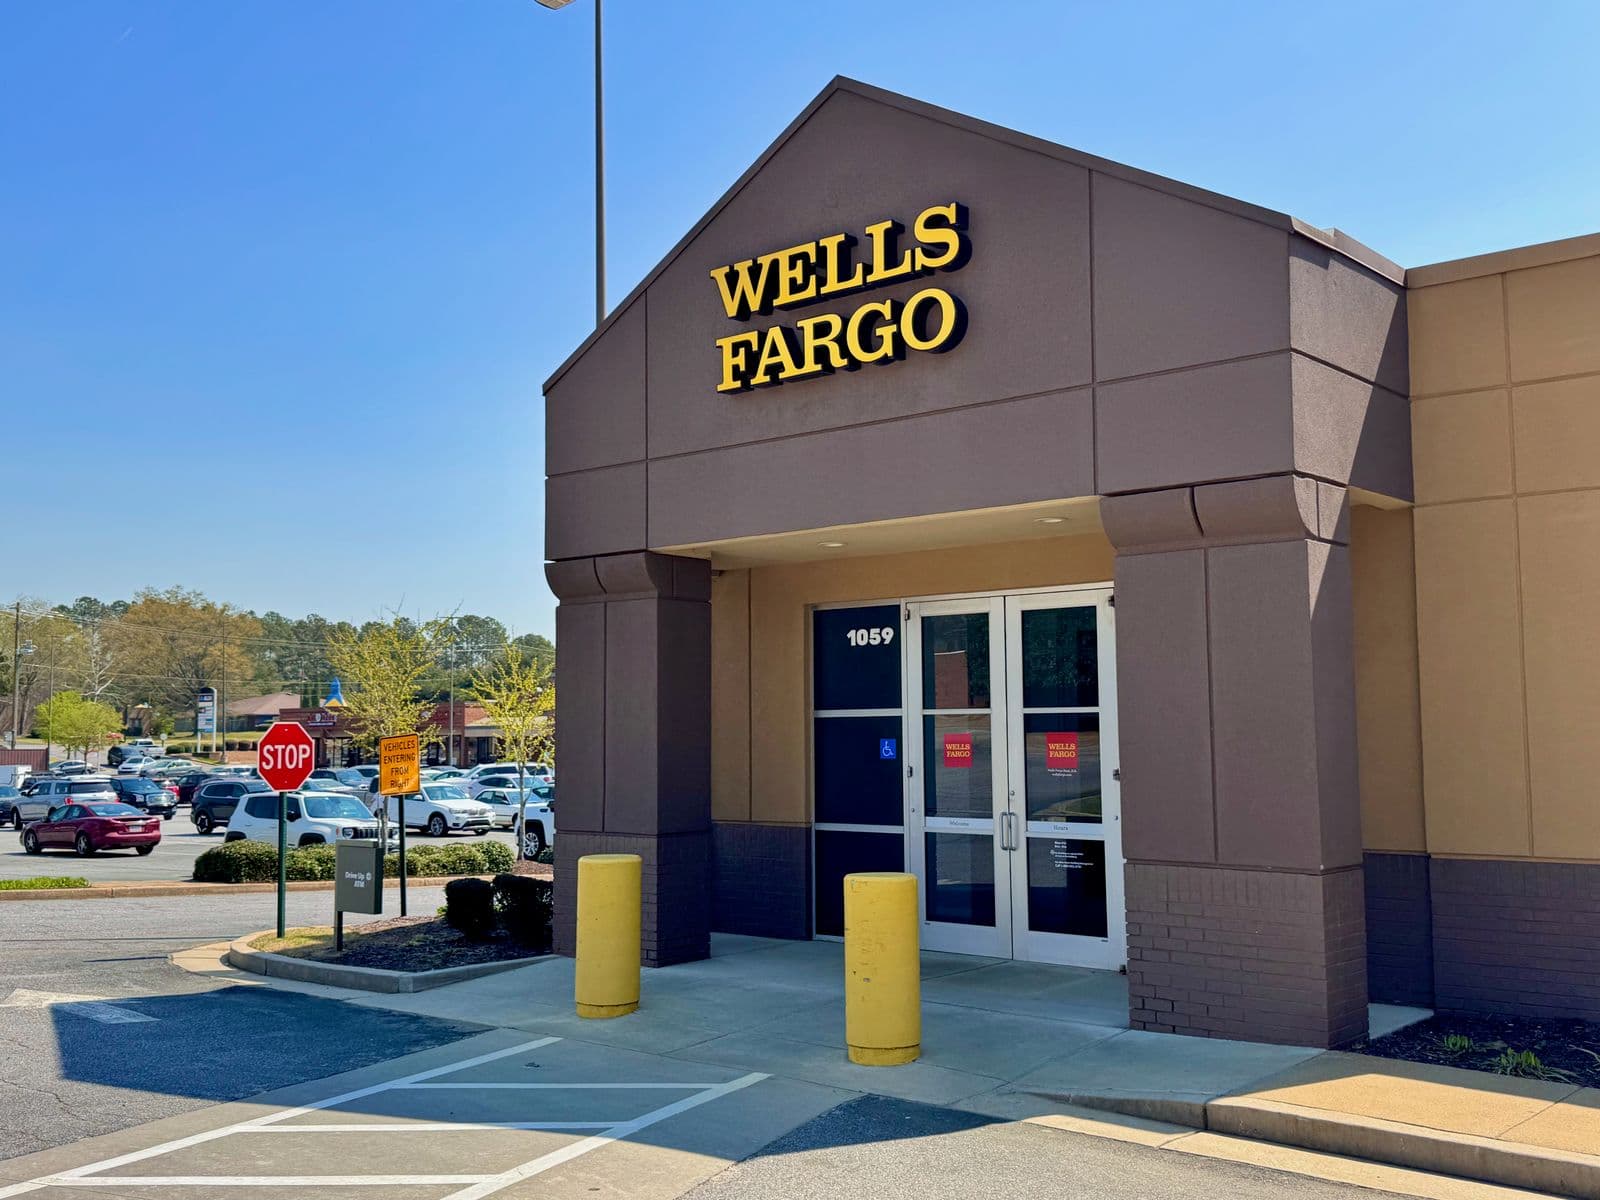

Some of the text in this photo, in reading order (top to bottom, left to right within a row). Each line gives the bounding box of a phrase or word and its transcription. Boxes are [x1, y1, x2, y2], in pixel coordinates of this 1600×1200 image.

[710, 203, 960, 318] WELLS
[716, 288, 956, 392] FARGO
[847, 627, 894, 646] 1059
[384, 740, 415, 751] VEHICLES
[262, 744, 311, 770] STOP
[384, 753, 415, 764] ENTERING
[391, 766, 409, 776] FROM
[391, 778, 409, 788] RIGHT
